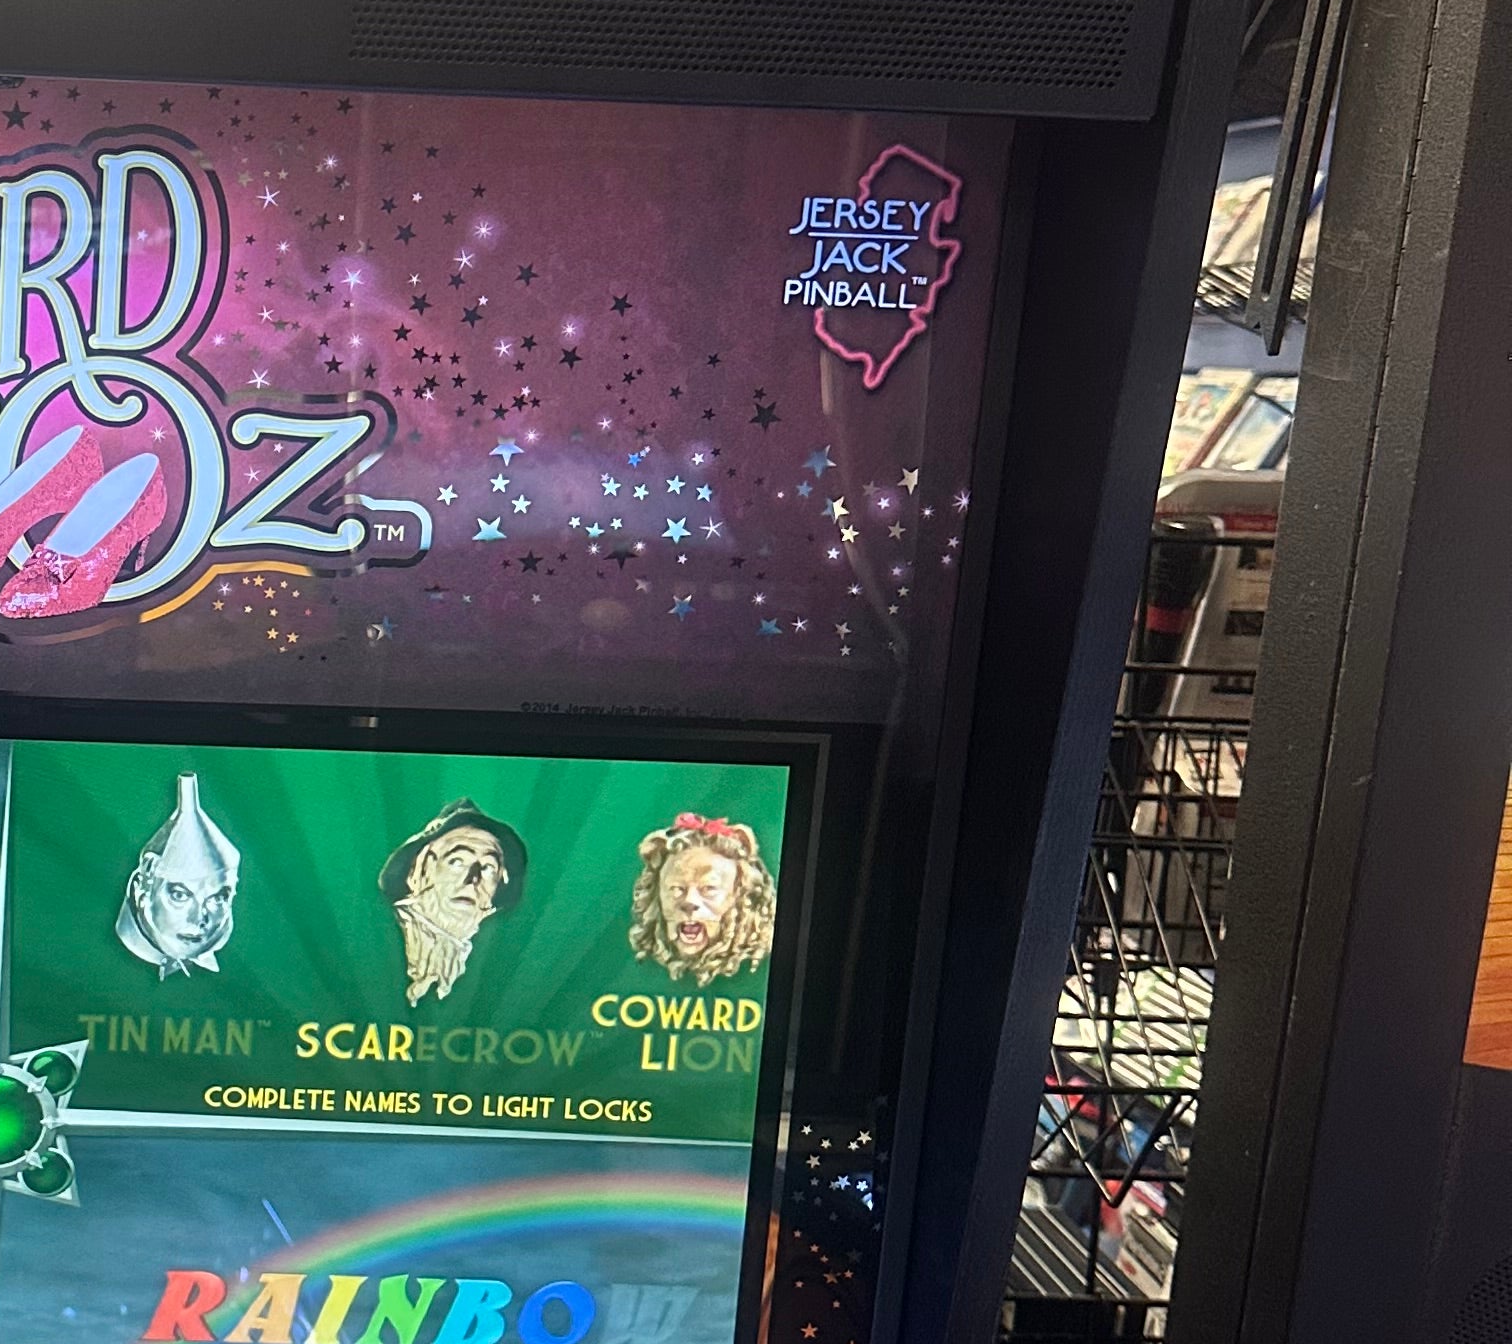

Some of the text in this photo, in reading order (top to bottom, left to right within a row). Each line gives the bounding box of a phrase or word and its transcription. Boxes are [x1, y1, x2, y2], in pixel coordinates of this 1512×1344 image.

[789, 196, 931, 235] JERSEY
[799, 239, 910, 280] JACK
[783, 278, 918, 309] PINBALL
[591, 994, 762, 1033] COWARD
[78, 1014, 150, 1053] TIN
[163, 1017, 253, 1056] MAN
[296, 1021, 586, 1067] SCARECROW
[640, 1033, 755, 1073] LION
[204, 1085, 653, 1122] COMPLETE NAMES TO LIGHT LOCKS
